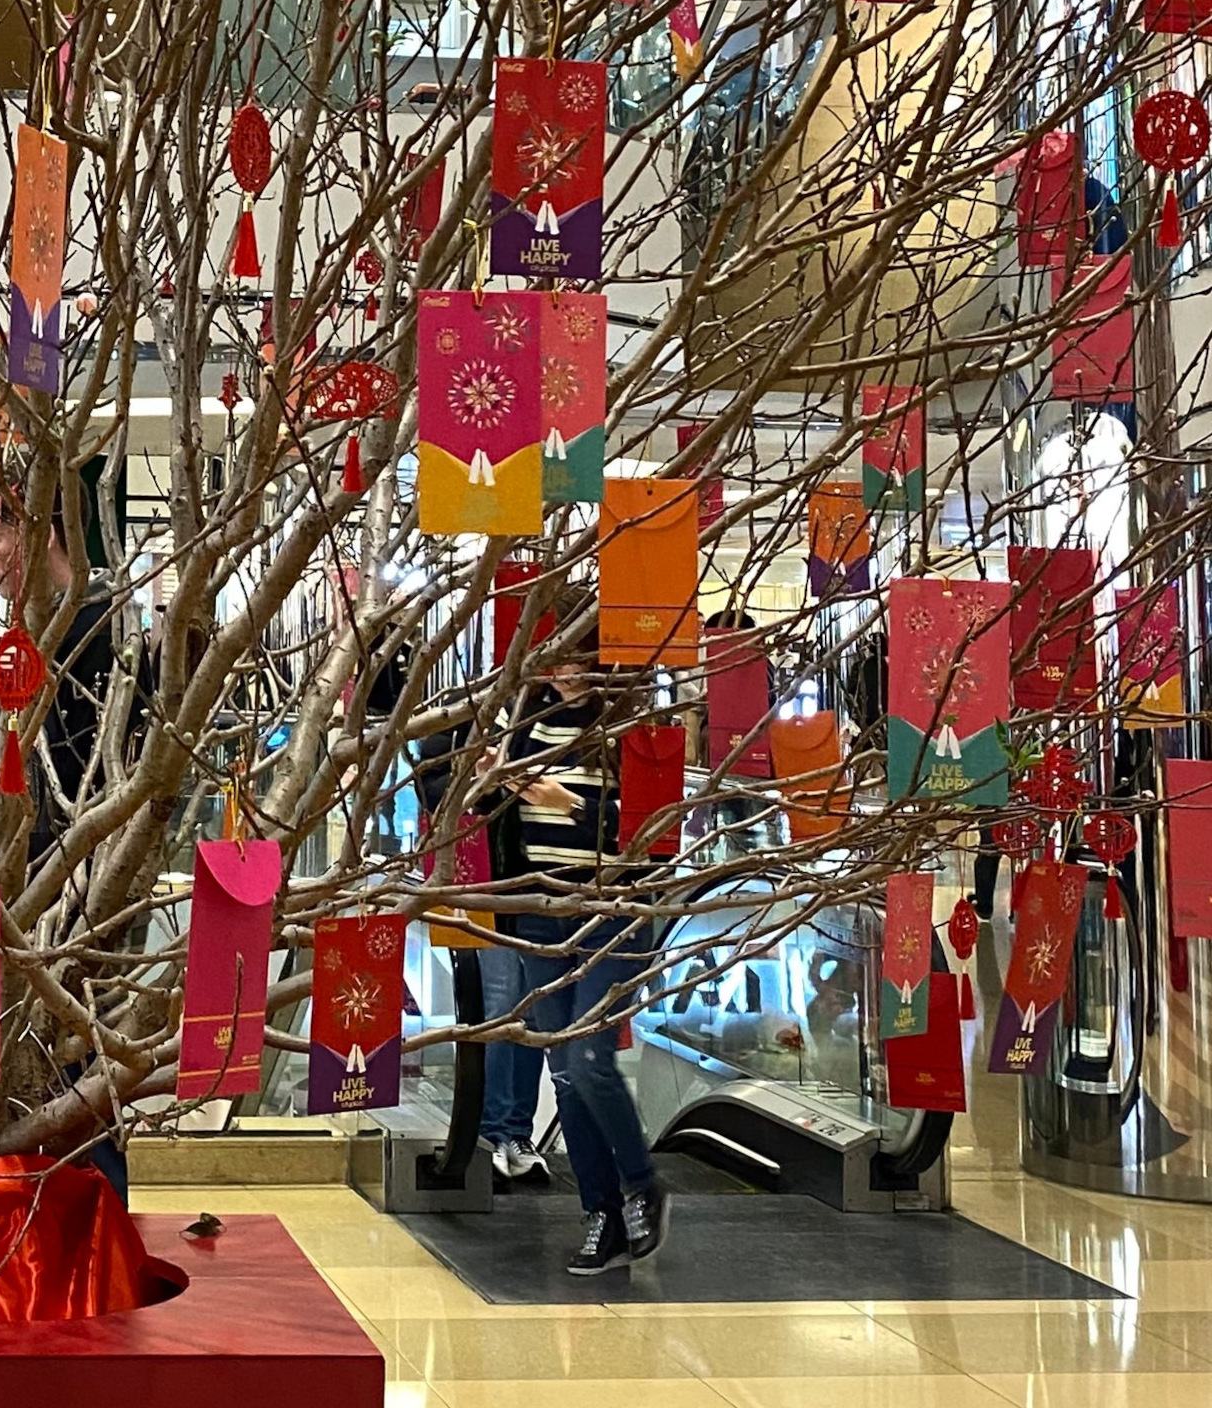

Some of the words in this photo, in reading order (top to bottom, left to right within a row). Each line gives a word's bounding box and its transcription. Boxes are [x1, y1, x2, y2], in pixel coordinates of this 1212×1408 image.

[530, 238, 560, 252] LIVE
[520, 250, 572, 266] HAPPY
[931, 763, 963, 778] LIVE
[1014, 1037, 1033, 1050] LIVE
[1006, 1048, 1036, 1063] HAPPY
[341, 1076, 366, 1090] LIVE
[332, 1087, 375, 1103] HAPPY
